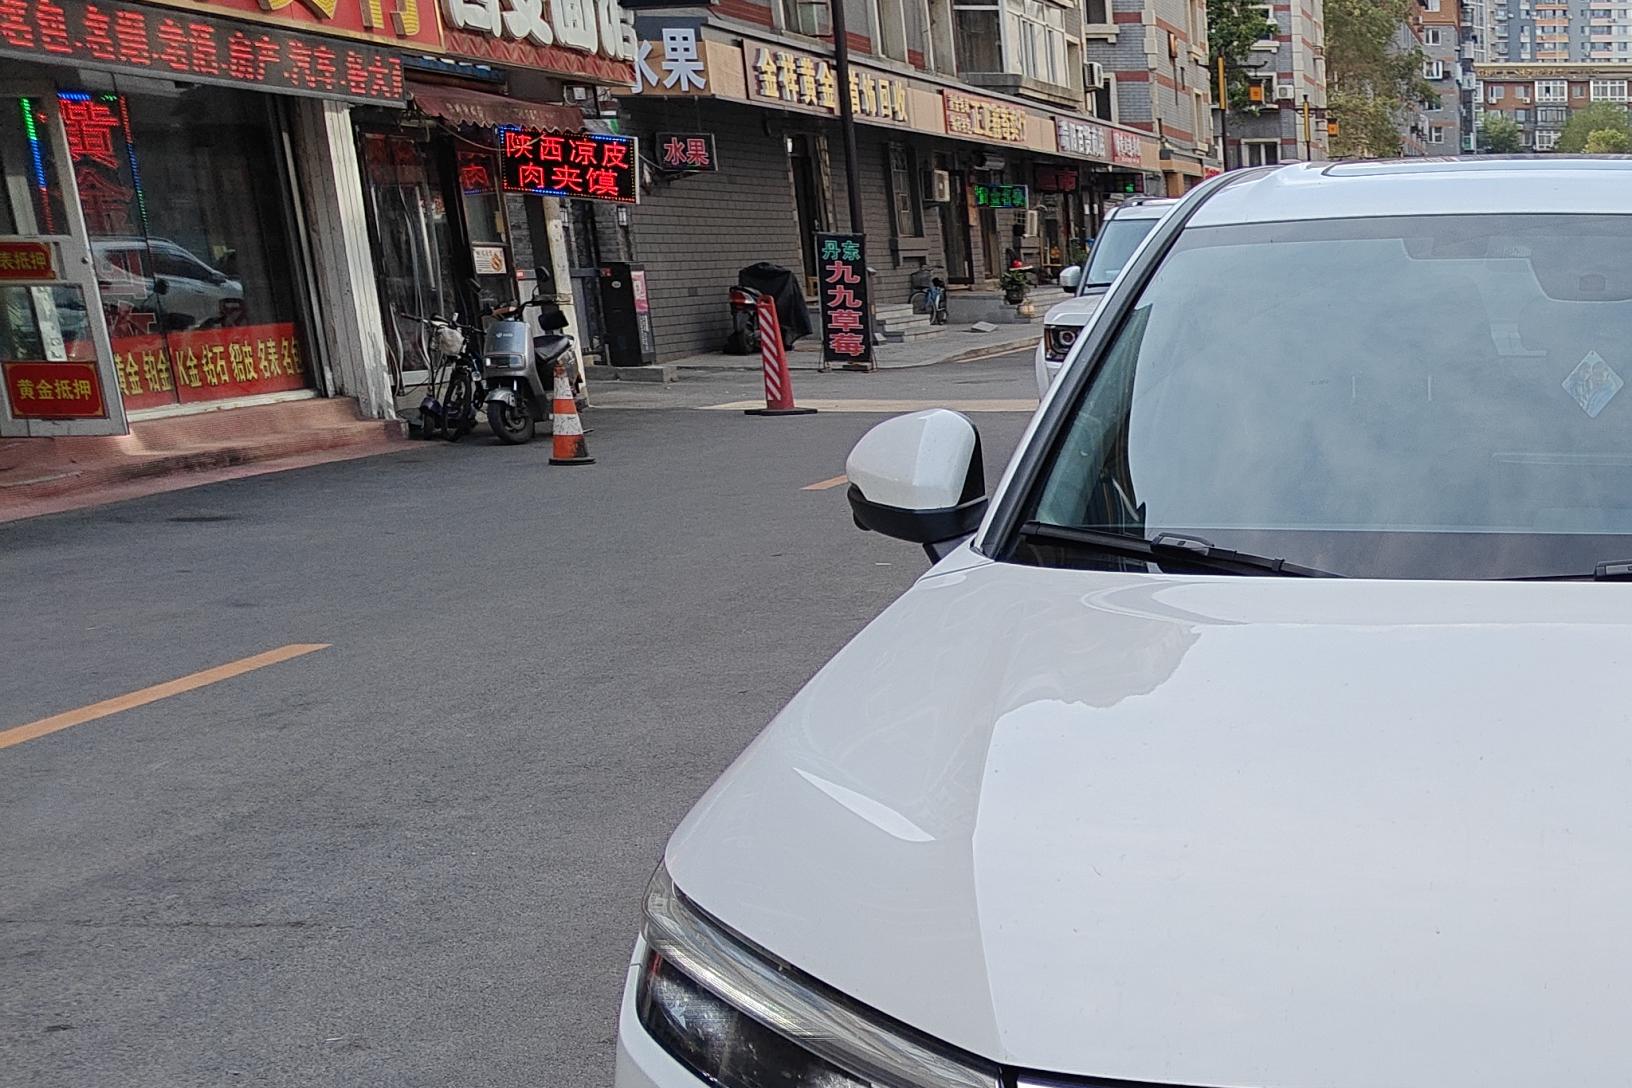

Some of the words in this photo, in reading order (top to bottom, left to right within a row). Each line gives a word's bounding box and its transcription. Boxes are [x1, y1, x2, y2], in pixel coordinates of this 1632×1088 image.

[505, 131, 629, 169] 陕西凉皮
[663, 137, 710, 165] 水果
[518, 162, 619, 196] 肉夹馍
[822, 240, 860, 260] 丹东
[826, 260, 865, 357] 九九草莓
[175, 347, 202, 388] K金
[17, 379, 91, 401] 黄金抵押
